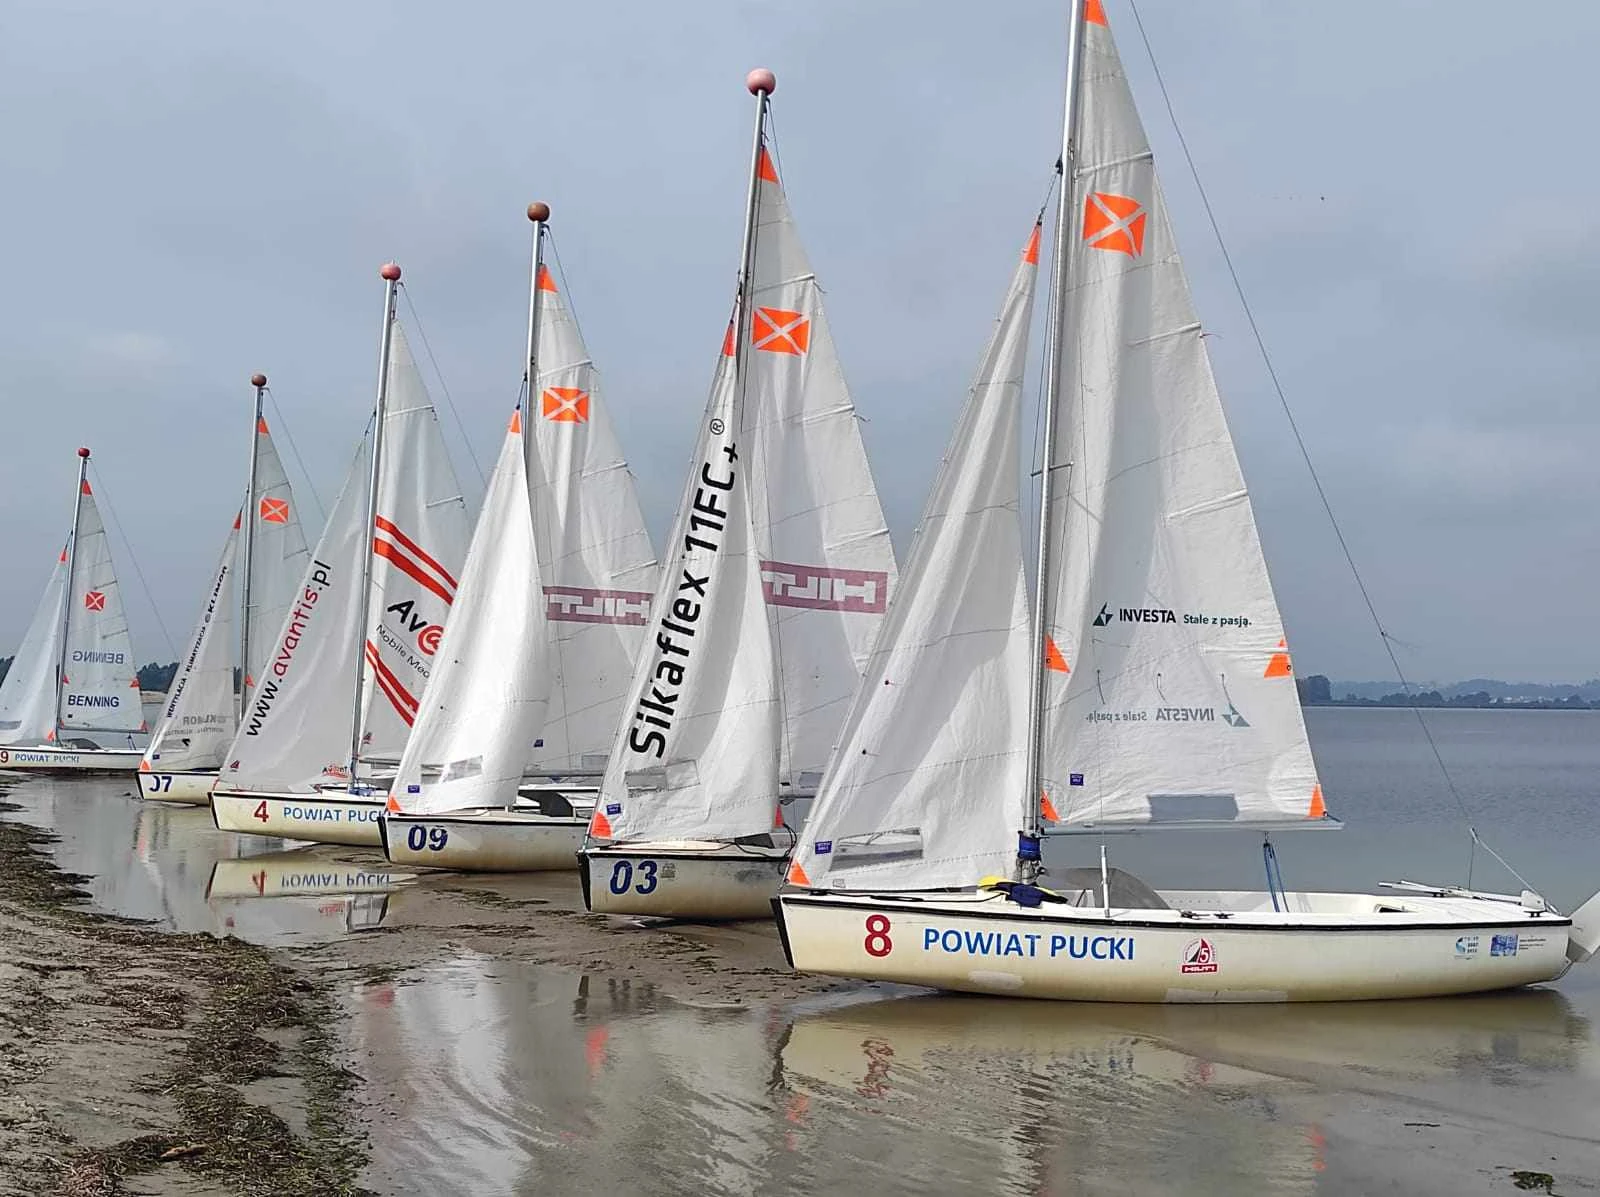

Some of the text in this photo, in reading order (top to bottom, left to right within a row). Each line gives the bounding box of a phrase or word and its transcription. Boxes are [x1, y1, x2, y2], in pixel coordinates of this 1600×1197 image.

[1119, 608, 1176, 624] INVESTA
[1183, 614, 1209, 625] Stale
[246, 560, 331, 736] www.avantis.pl
[376, 624, 407, 657] Mobile
[629, 569, 710, 759] Sikaflex
[68, 695, 120, 708] BENNING
[15, 753, 49, 762] POWIAT
[254, 801, 269, 823] 4
[284, 807, 342, 822] POWIAT
[407, 825, 449, 851] 09
[610, 860, 658, 895] 03
[864, 914, 892, 957] 8
[923, 928, 1135, 961] POWIAT PUCKI
